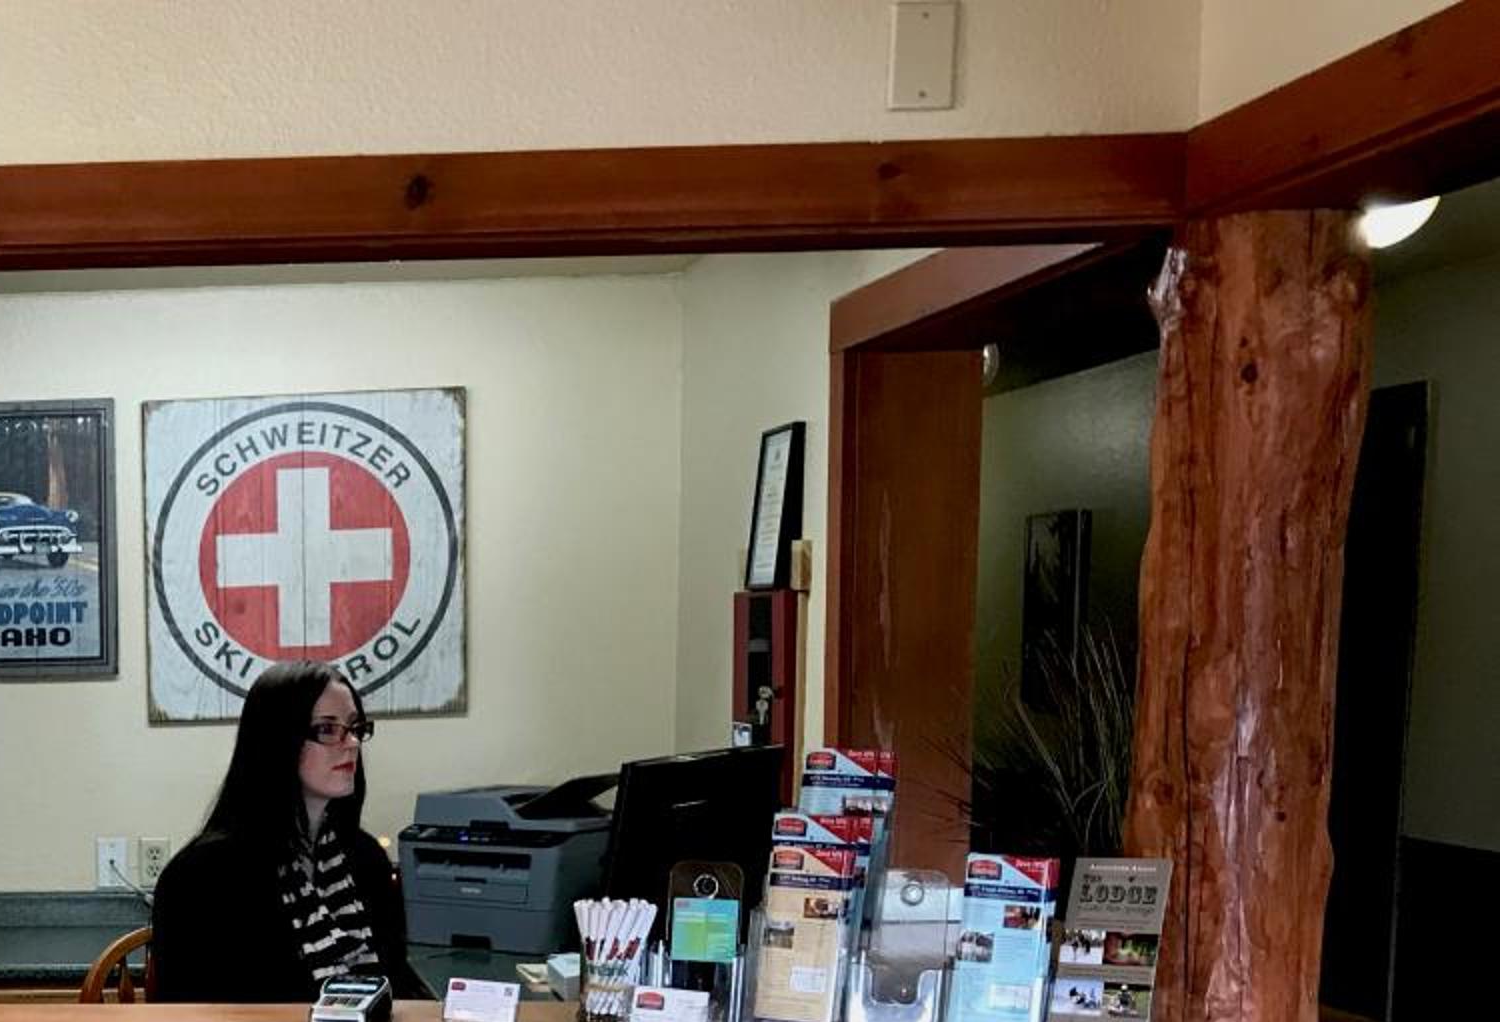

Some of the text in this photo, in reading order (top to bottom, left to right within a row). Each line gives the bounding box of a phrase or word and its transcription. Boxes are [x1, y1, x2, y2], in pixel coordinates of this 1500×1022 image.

[196, 421, 411, 496] SCHWEITZER
[194, 621, 253, 679] SKI
[1080, 883, 1158, 905] LODGE
